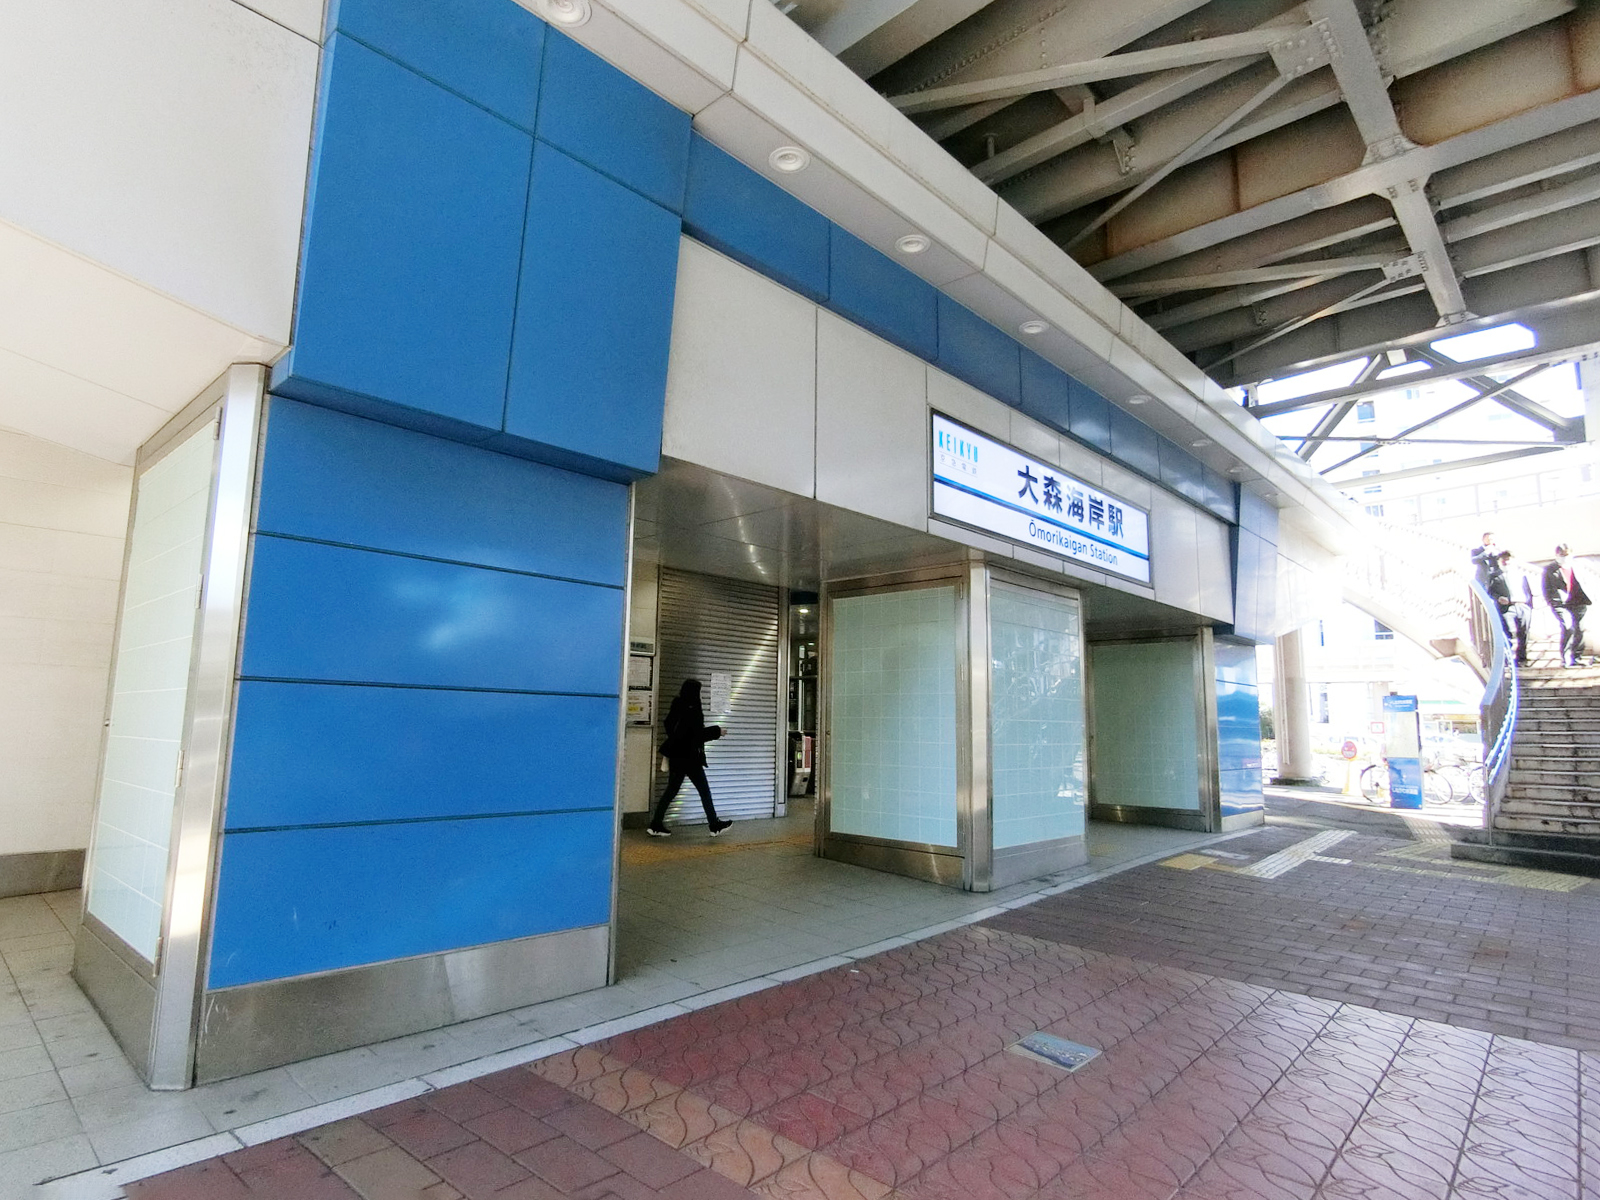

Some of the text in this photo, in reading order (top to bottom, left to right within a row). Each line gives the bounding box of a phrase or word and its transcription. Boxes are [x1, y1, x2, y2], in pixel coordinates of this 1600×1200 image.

[938, 430, 979, 463] KEIKYU
[1017, 466, 1124, 538] 大森海岸駅
[1028, 519, 1119, 565] Ōmorikaigan Station
